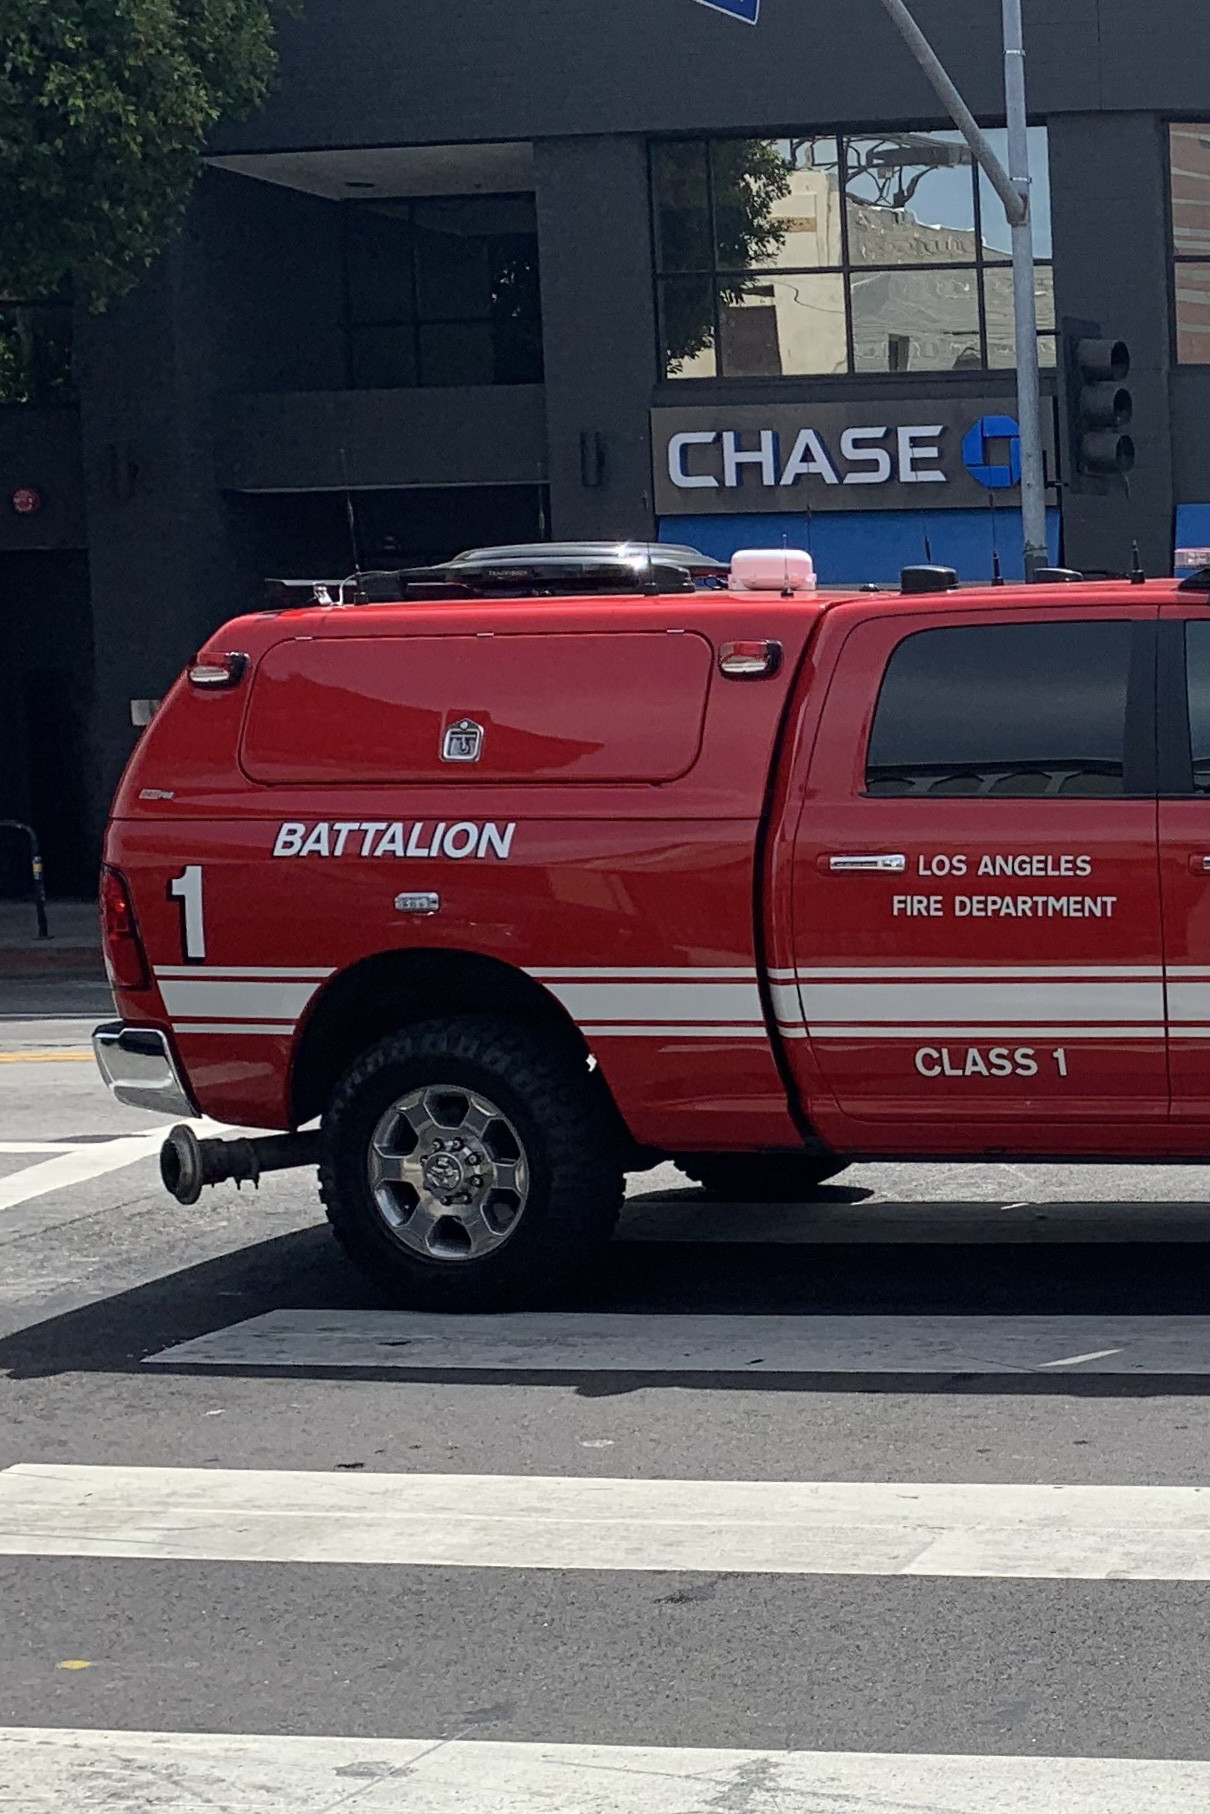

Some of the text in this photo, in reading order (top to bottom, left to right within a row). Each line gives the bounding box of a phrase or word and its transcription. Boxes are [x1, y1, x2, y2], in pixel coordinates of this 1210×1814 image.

[667, 425, 947, 488] CHASE
[272, 821, 516, 859] BATTALION
[918, 854, 1093, 877] LOS ANGELES
[170, 864, 207, 960] 1
[892, 894, 1117, 918] FIRE DEPARTMENT
[914, 1047, 1068, 1077] CLASS 1
